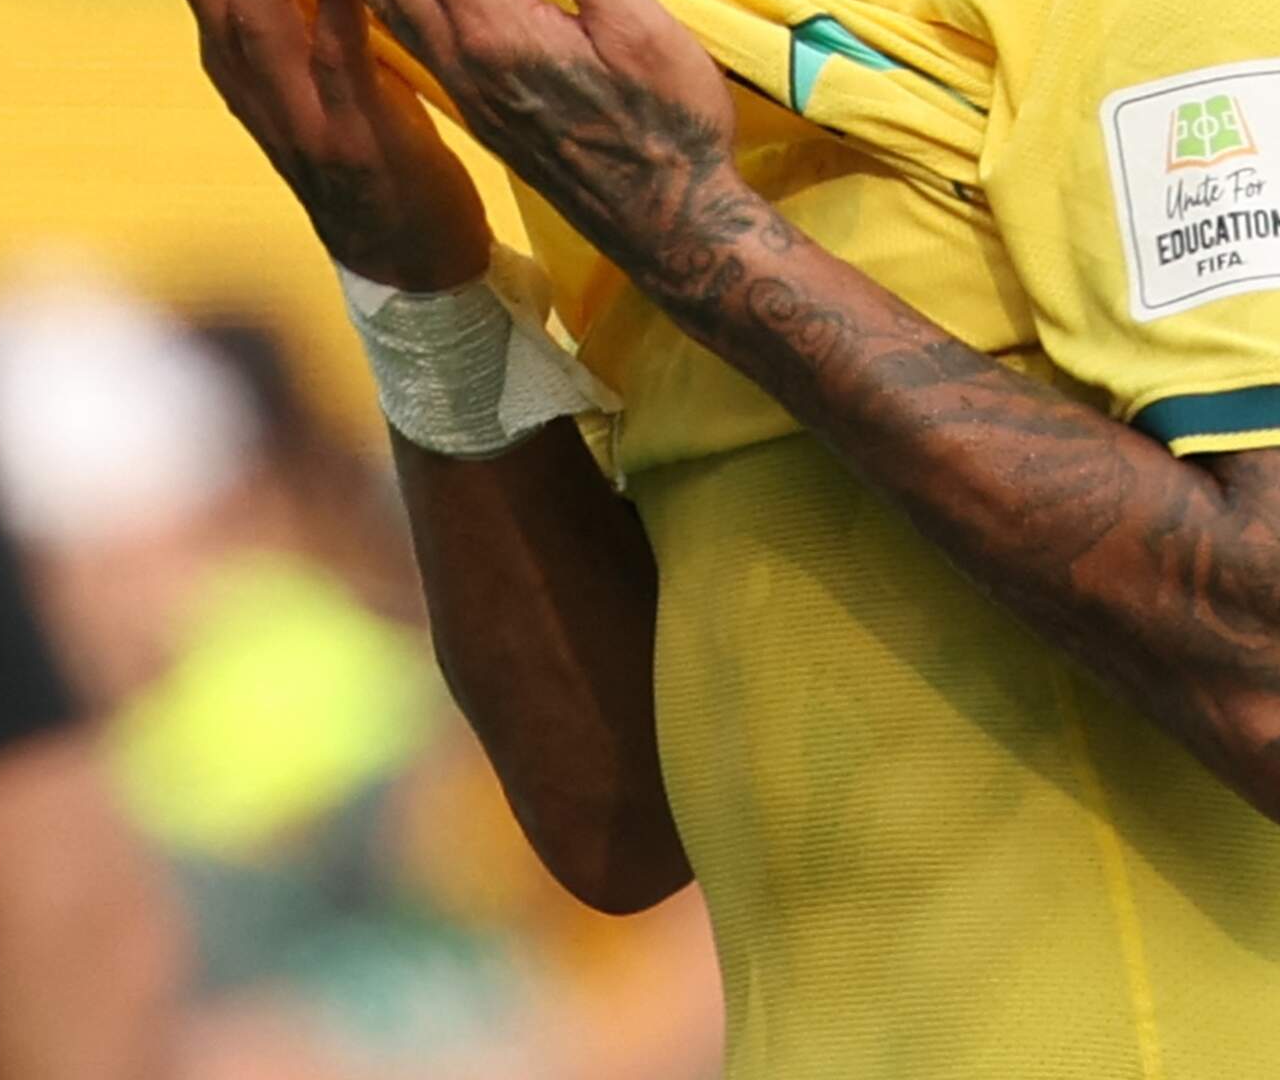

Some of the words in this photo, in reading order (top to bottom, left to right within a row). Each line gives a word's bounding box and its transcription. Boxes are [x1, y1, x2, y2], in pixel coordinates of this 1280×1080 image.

[1166, 174, 1223, 220] Unite
[1226, 167, 1266, 203] For
[1196, 251, 1243, 277] FIFA
